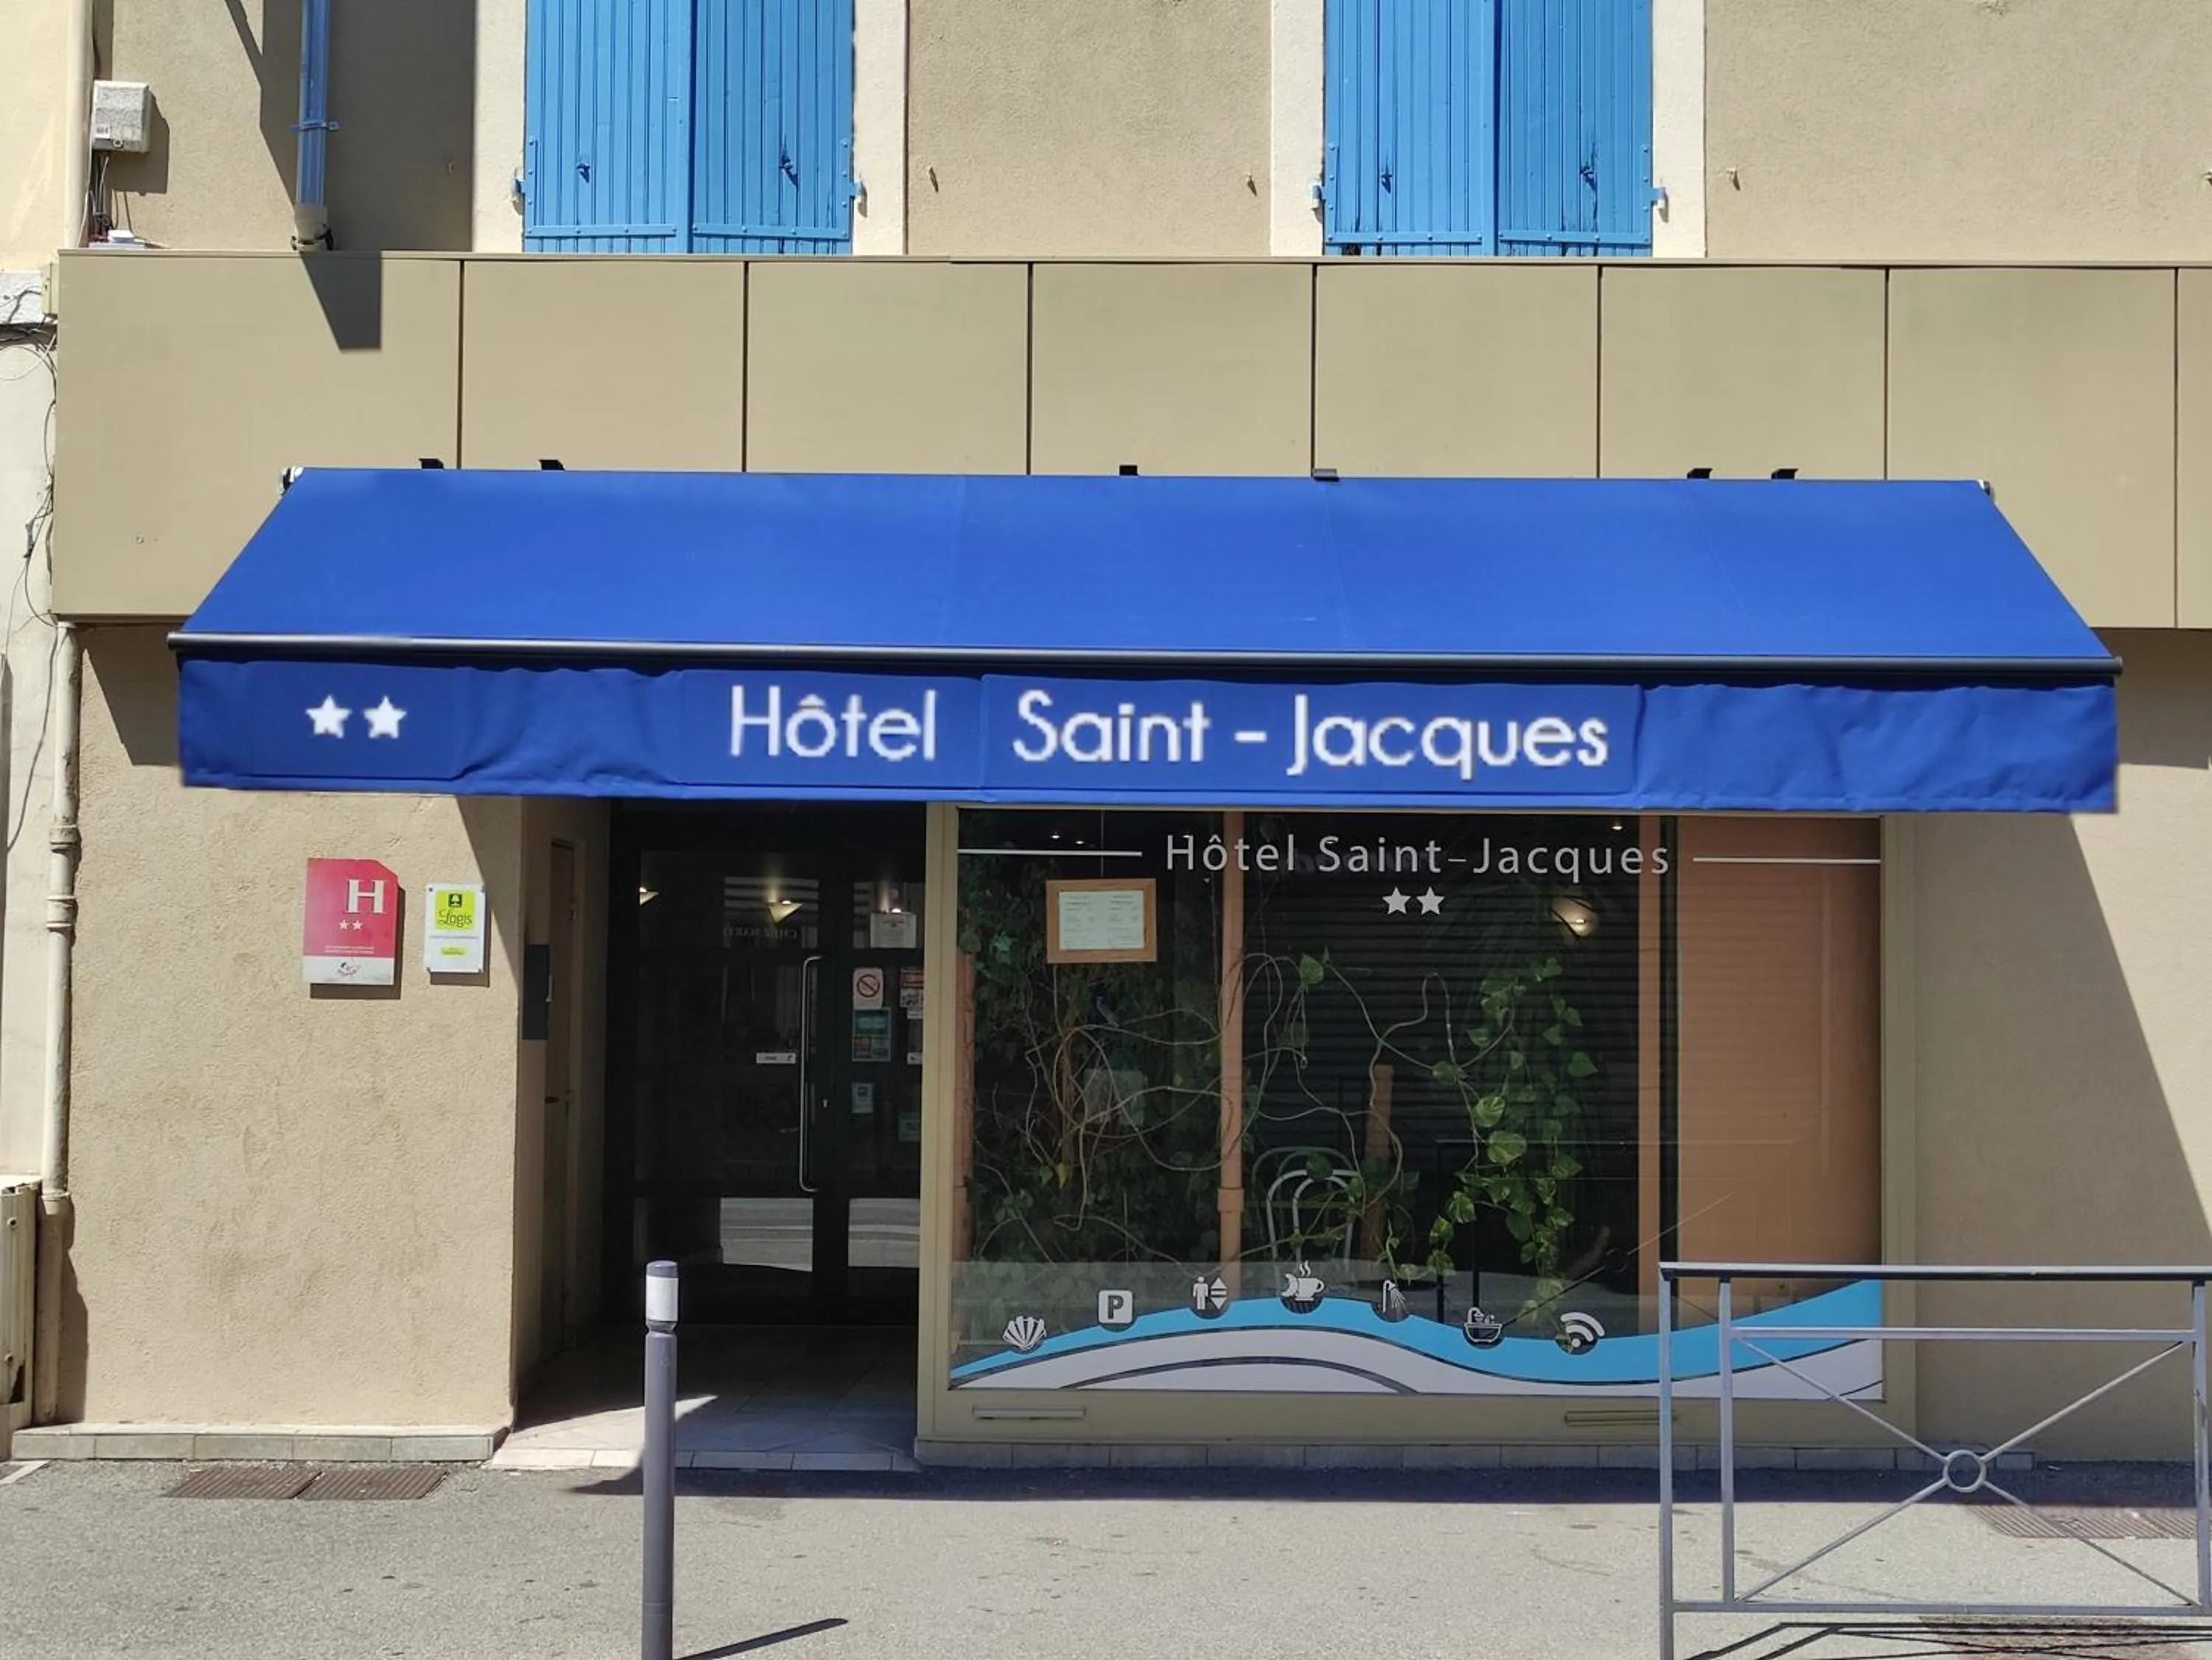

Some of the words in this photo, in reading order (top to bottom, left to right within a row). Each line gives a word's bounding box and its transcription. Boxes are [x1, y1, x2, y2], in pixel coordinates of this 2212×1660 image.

[731, 685, 937, 761] Hôtel
[1013, 688, 1211, 762] Saint
[1286, 694, 1609, 780] Jacques
[1167, 834, 1295, 871] Hôtel
[346, 879, 386, 914] H
[1108, 1295, 1124, 1319] P
